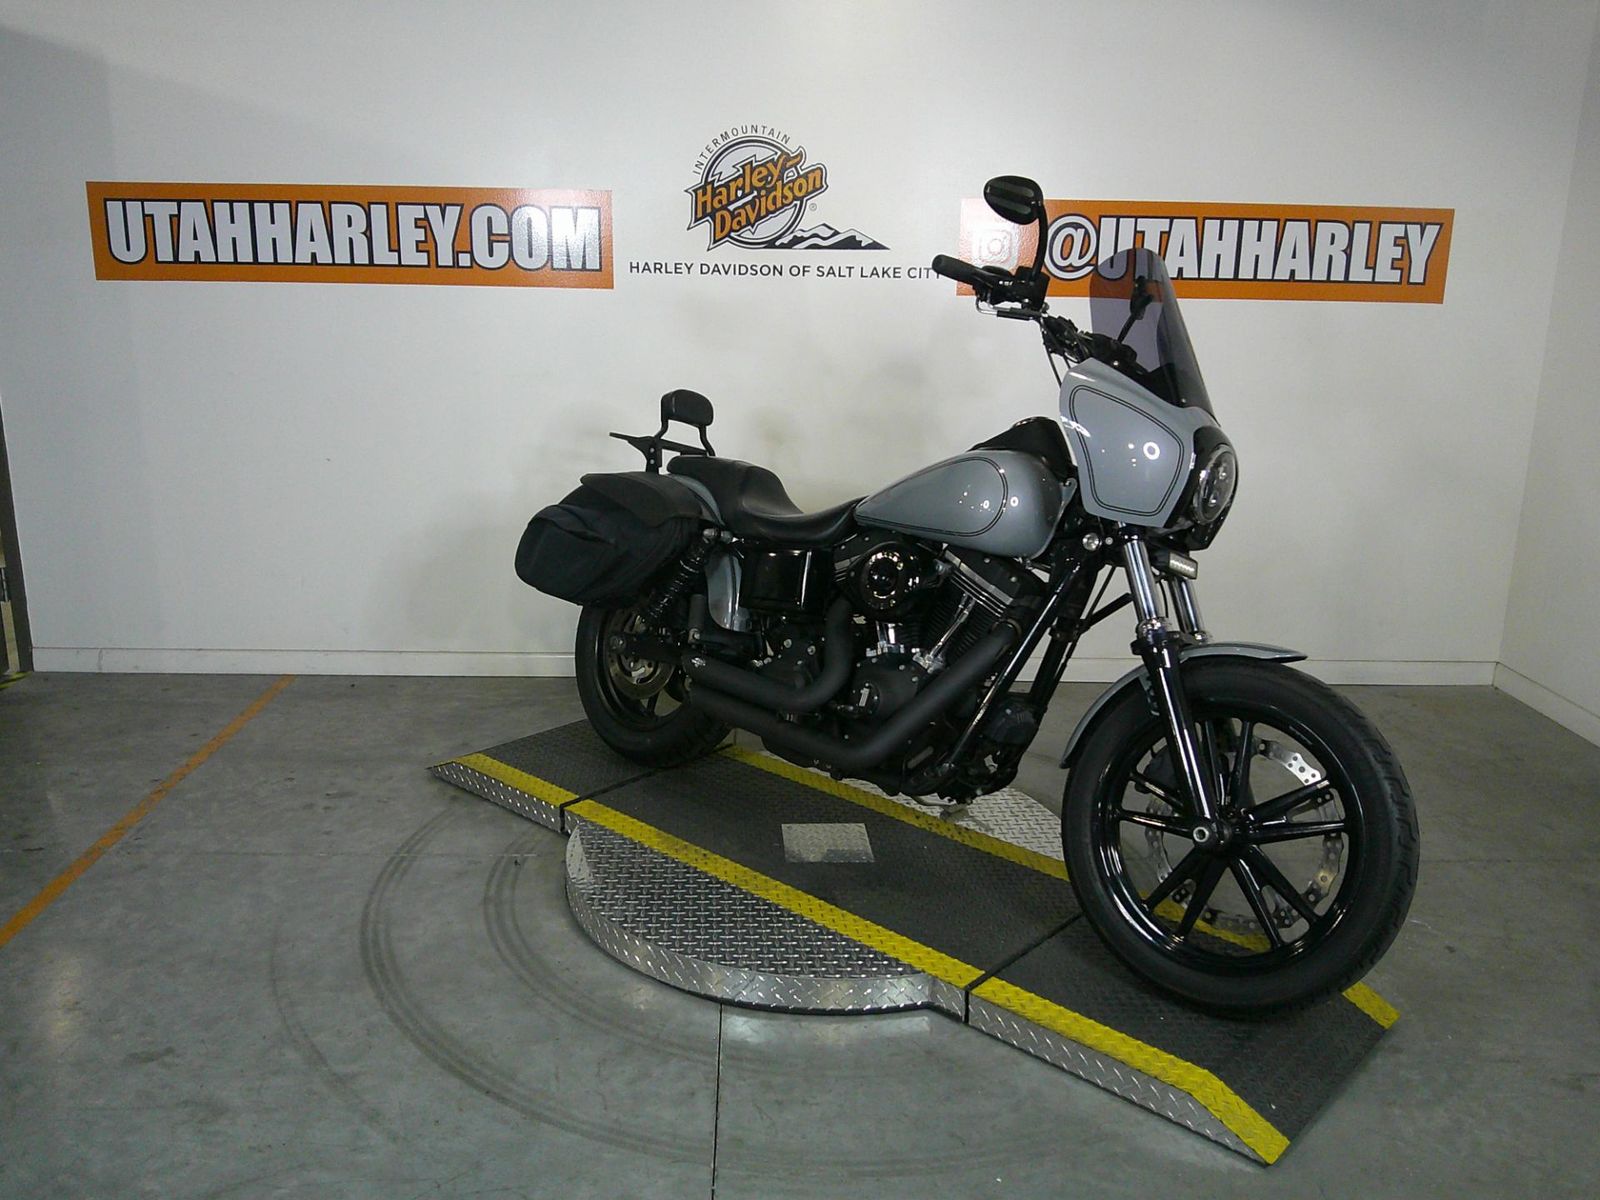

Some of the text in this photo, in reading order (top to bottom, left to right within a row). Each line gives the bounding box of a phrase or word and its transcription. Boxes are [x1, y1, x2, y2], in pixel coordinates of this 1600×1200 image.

[693, 125, 790, 174] INTERMOUNTAIN
[103, 198, 603, 271] UTAHHARLEY.COM
[715, 169, 822, 240] Davidson
[629, 262, 693, 275] HARLEY
[700, 263, 783, 277] DAVIDSON
[789, 264, 811, 277] OF
[816, 265, 854, 278] SALT
[860, 266, 900, 279] LAKE
[1044, 214, 1444, 285] @UTAHHARLEY
